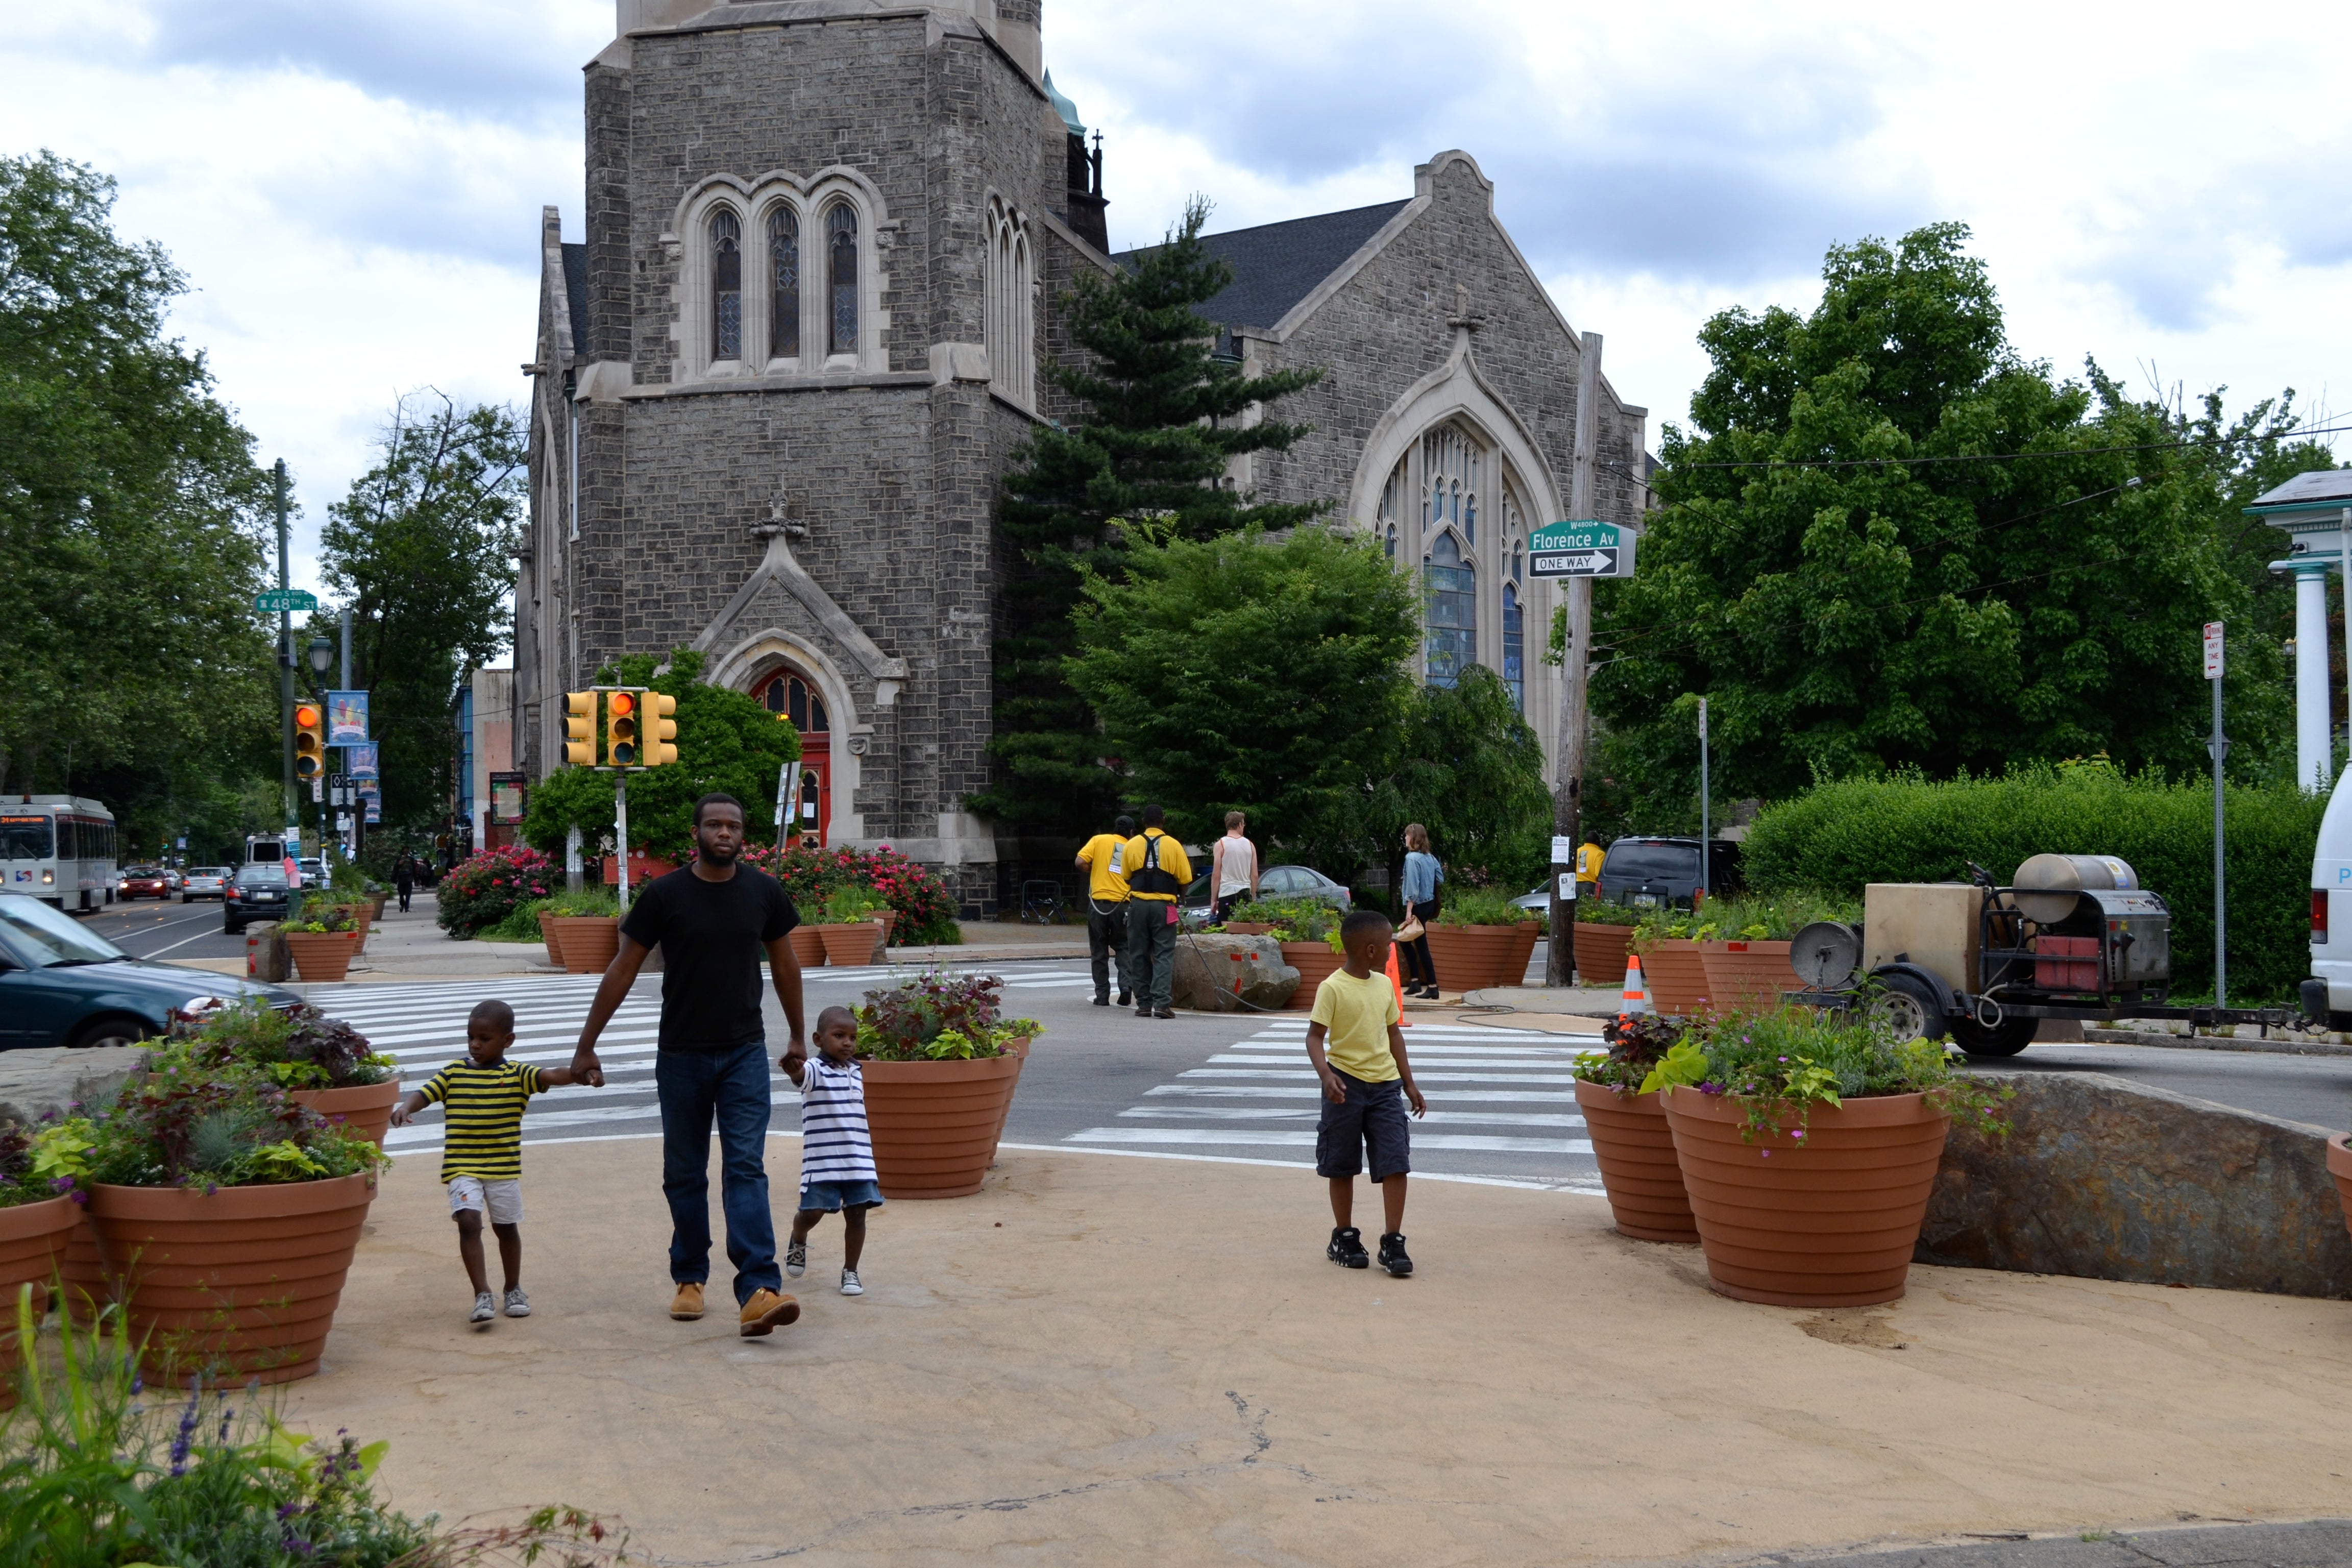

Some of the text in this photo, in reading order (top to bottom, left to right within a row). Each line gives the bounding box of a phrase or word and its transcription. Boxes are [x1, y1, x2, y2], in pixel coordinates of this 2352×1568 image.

[1533, 532, 1614, 549] Florence Av
[1540, 557, 1591, 569] ONE WAY
[304, 601, 315, 609] ST
